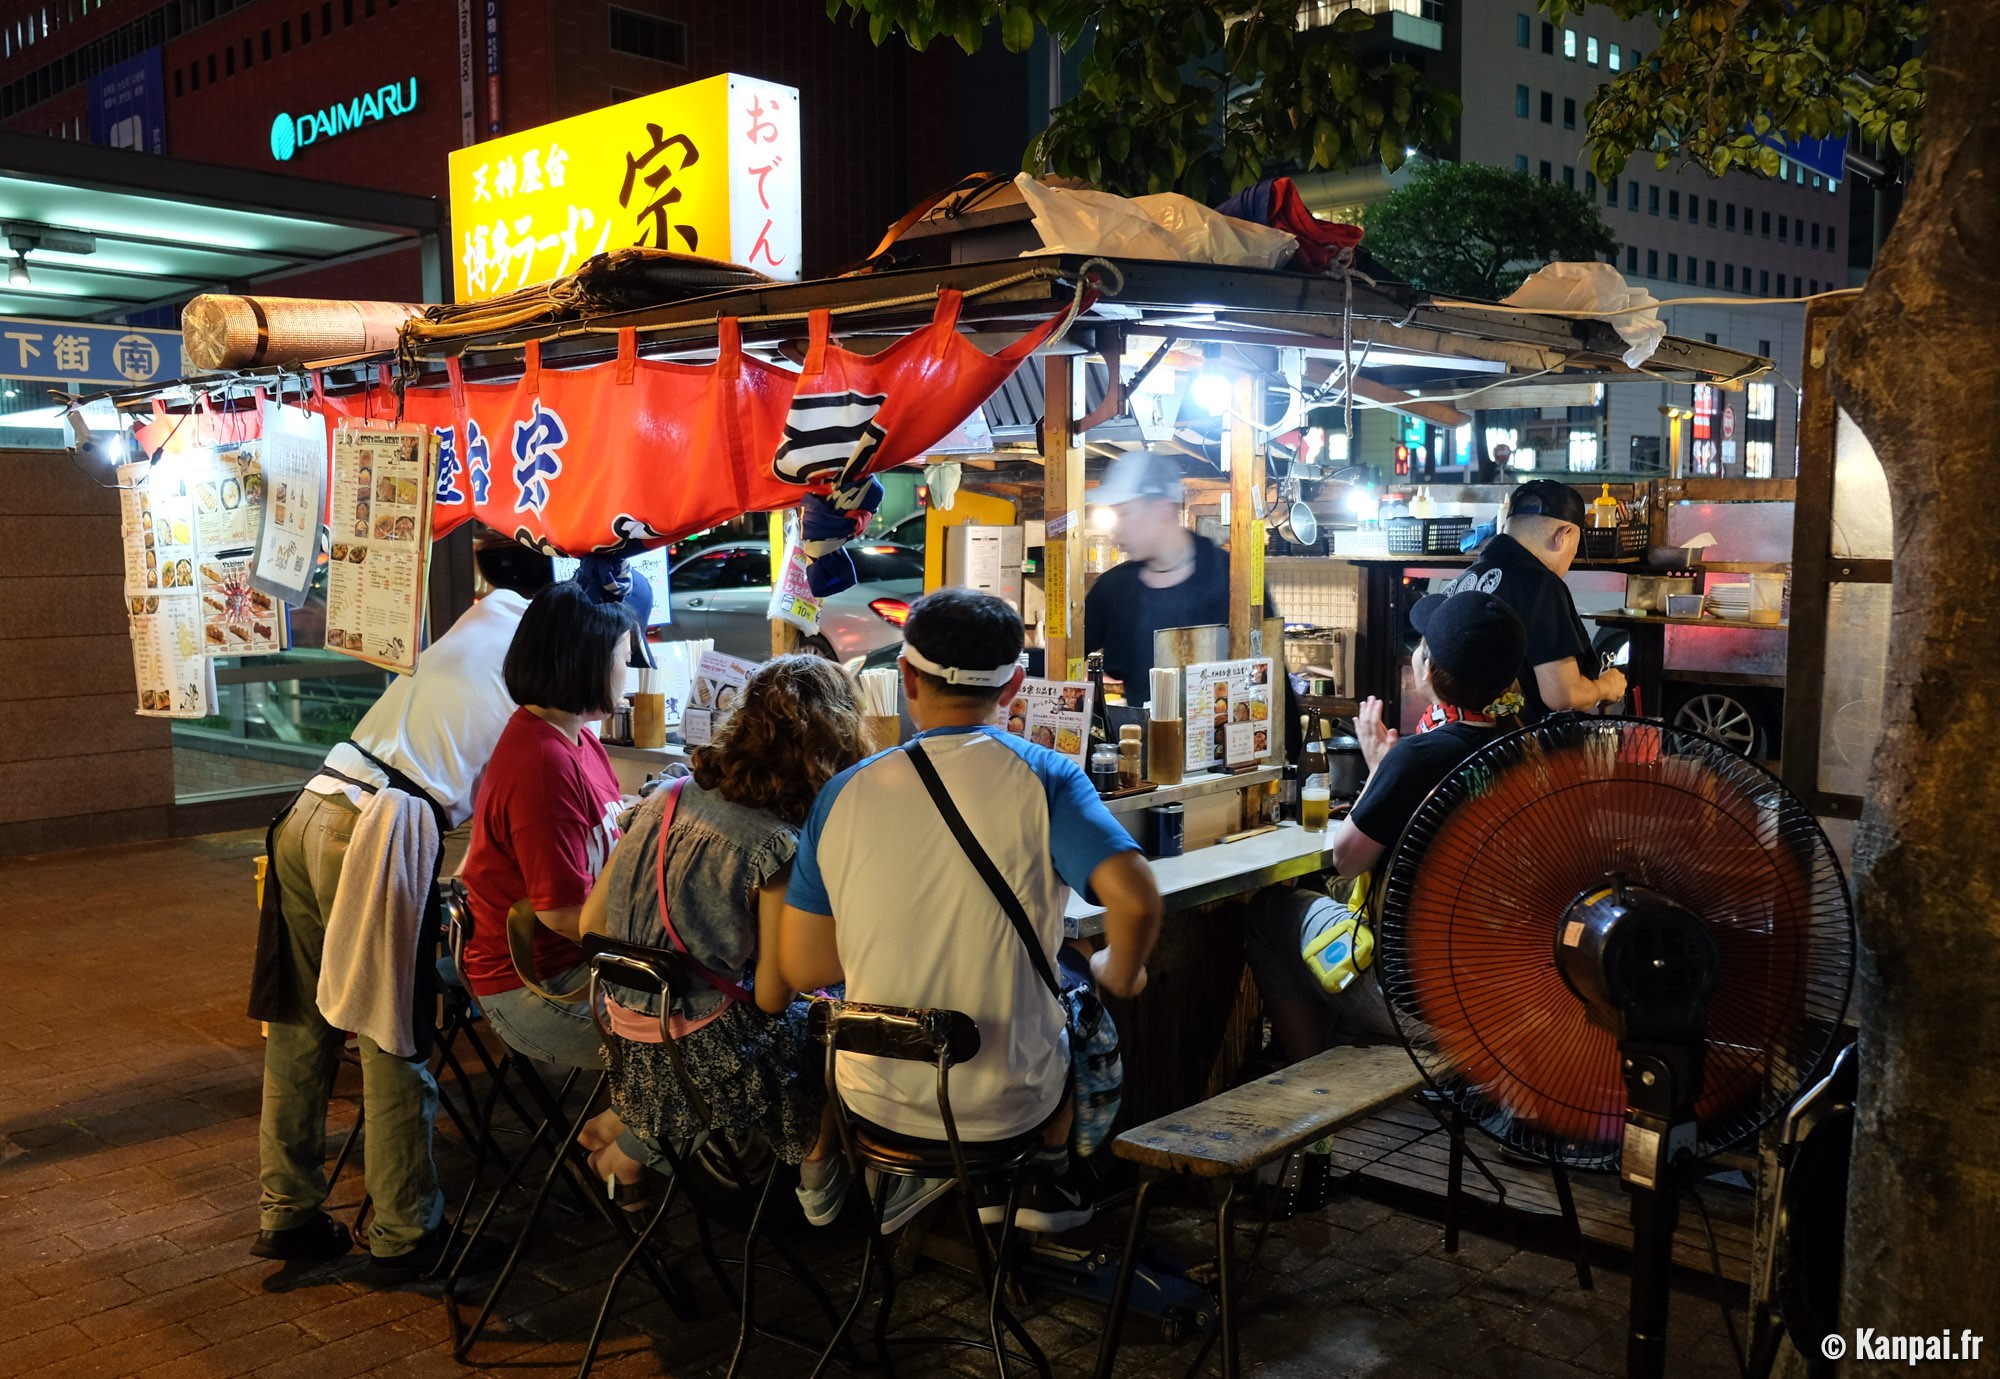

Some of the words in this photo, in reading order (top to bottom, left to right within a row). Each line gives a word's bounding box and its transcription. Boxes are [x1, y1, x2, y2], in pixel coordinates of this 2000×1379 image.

[461, 43, 470, 82] Shop
[297, 76, 417, 147] DAIMARU
[472, 143, 569, 203] 天神屋台
[619, 122, 699, 252] 宗
[746, 95, 787, 266] おでん
[463, 204, 611, 297] 博多ラーメン
[4, 331, 91, 372] 下街
[118, 340, 153, 376] 南
